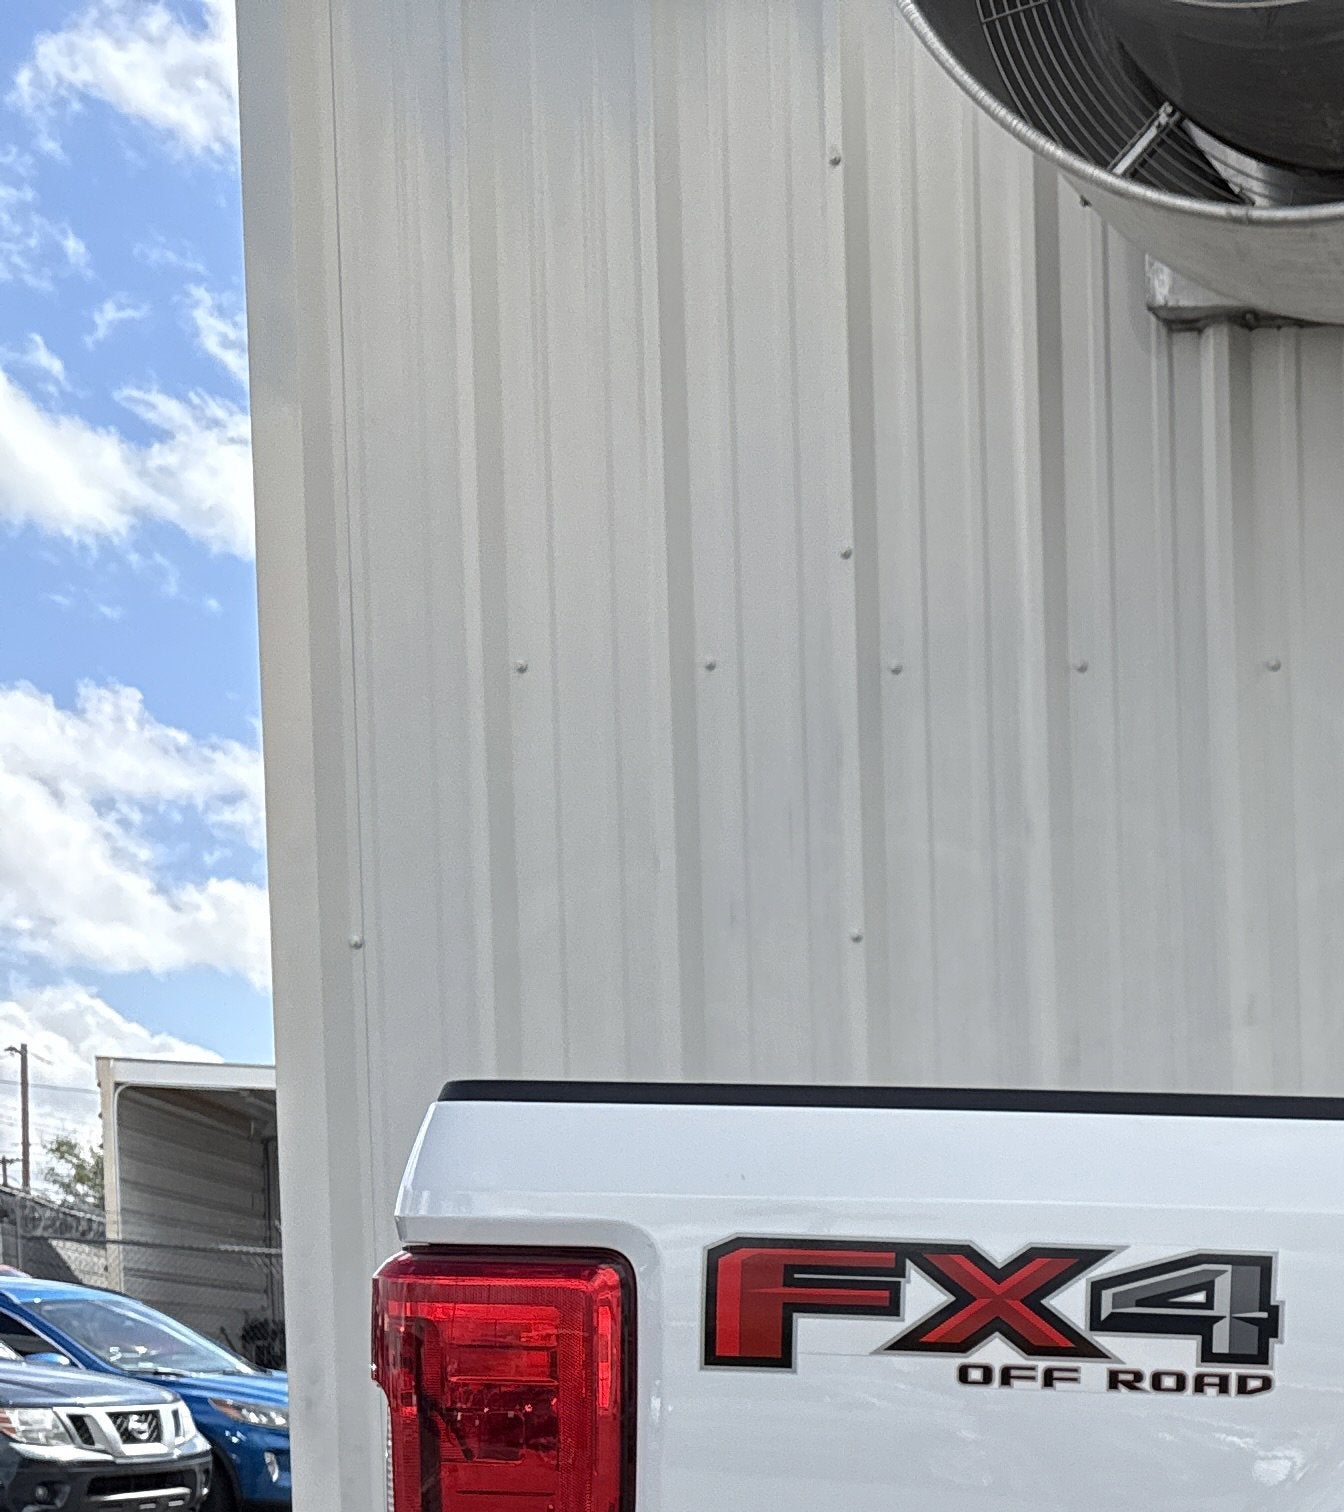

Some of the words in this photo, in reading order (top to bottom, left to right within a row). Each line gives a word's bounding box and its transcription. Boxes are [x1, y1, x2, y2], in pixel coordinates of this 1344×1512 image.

[699, 1232, 1285, 1374] FX4
[957, 1361, 1083, 1391] OFF
[1105, 1367, 1275, 1398] ROAD
